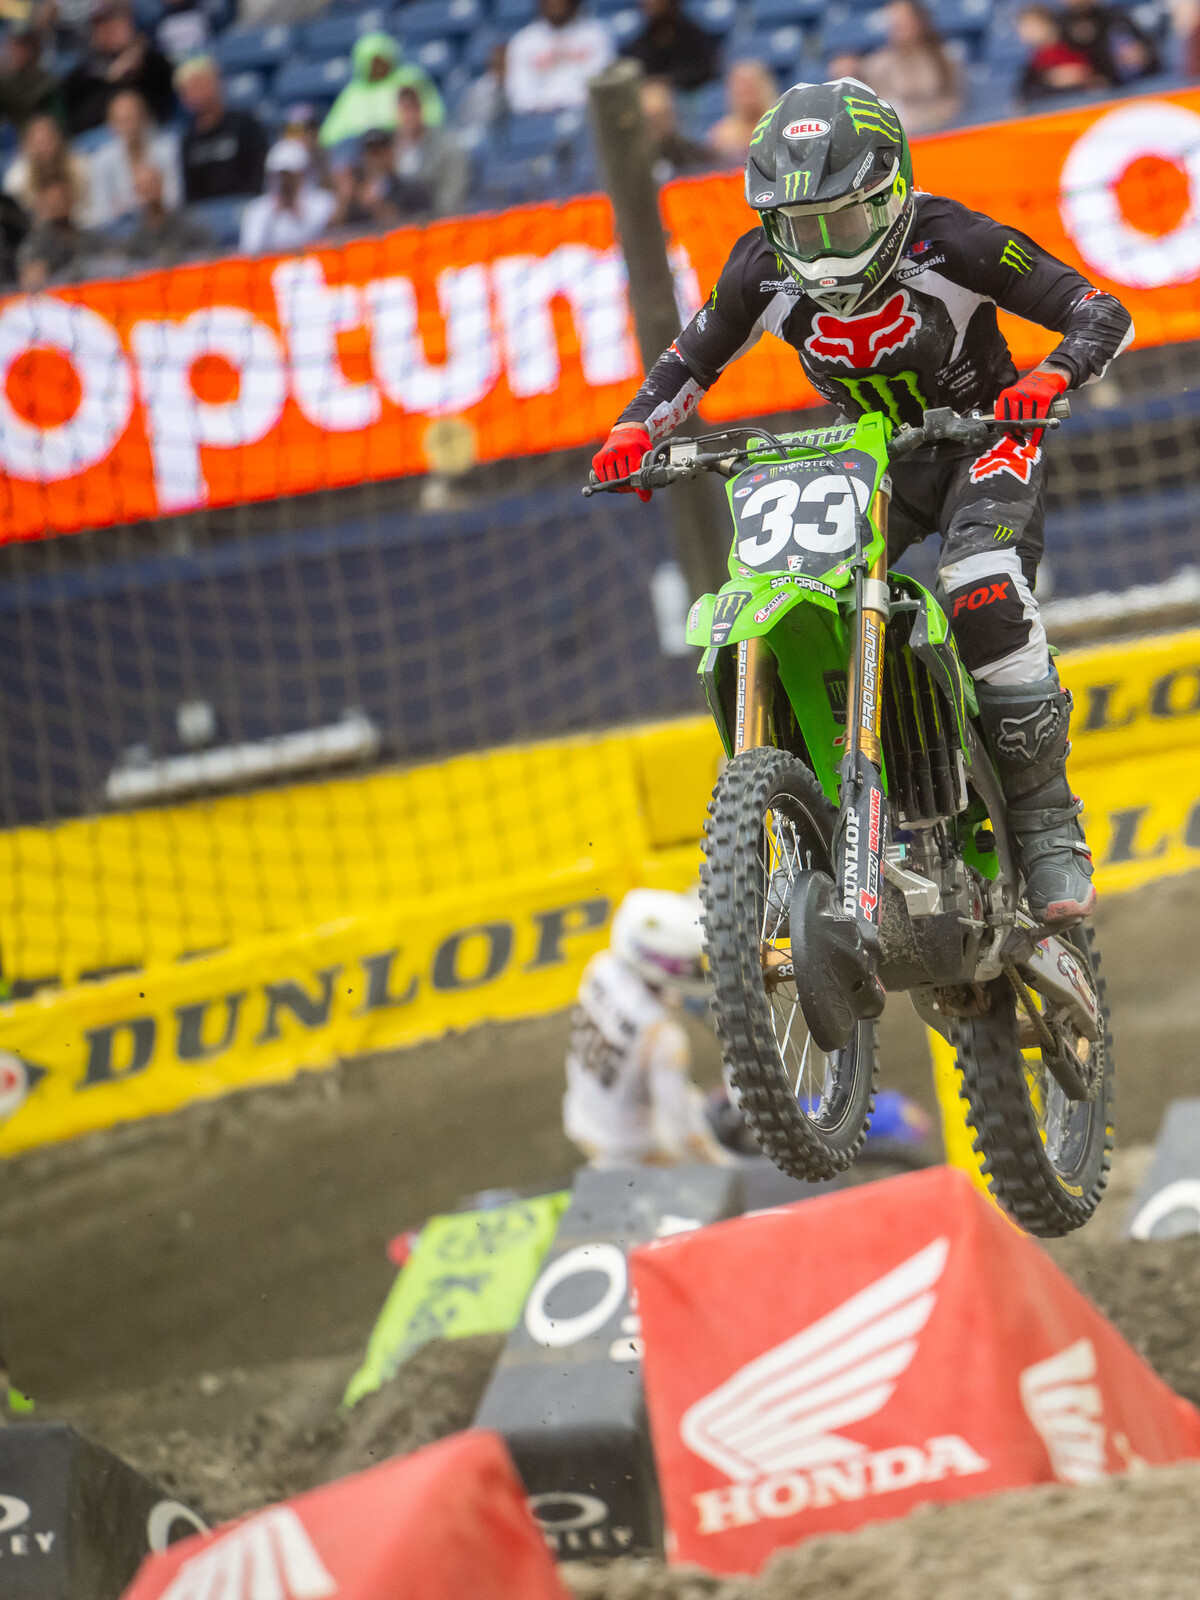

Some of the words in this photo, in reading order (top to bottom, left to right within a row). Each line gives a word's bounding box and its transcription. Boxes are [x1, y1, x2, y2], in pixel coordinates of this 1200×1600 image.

[791, 124, 822, 134] BELL
[895, 254, 946, 281] Kawasaki
[0, 241, 703, 512] Optum
[738, 475, 870, 567] 33
[770, 577, 792, 589] PRO
[953, 582, 1009, 618] FOX
[863, 618, 878, 692] CIRCUIT
[861, 690, 876, 732] PRO
[868, 787, 881, 854] BRAKING
[843, 806, 860, 917] DUNLOP
[76, 898, 612, 1091] DUNLOP
[777, 963, 795, 977] 33
[692, 1434, 991, 1536] HONDA
